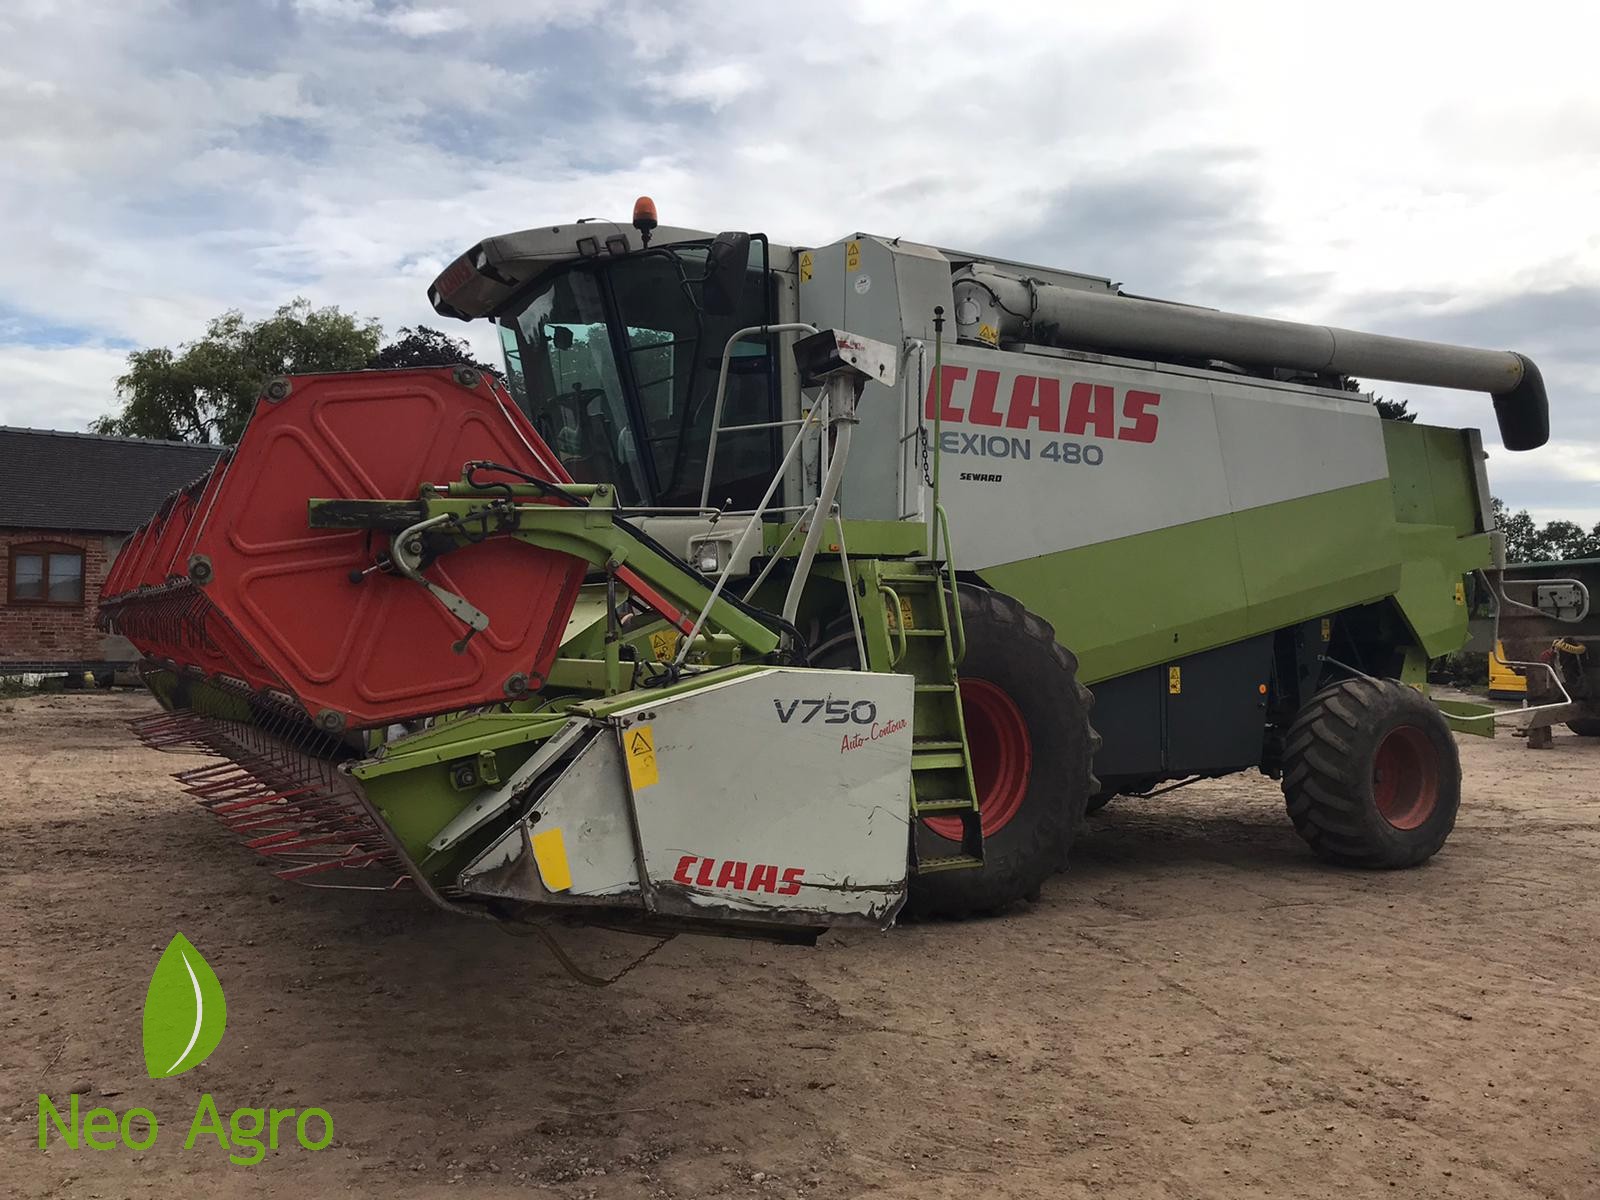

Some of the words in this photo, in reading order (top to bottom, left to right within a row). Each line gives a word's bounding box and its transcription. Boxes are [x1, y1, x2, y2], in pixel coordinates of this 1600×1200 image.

[925, 365, 1161, 443] CLAAS
[1040, 441, 1104, 466] 480
[959, 472, 1002, 482] SEWARD
[773, 698, 877, 724] V750
[841, 719, 908, 754] Auto-Contour
[672, 855, 806, 896] CLAAS
